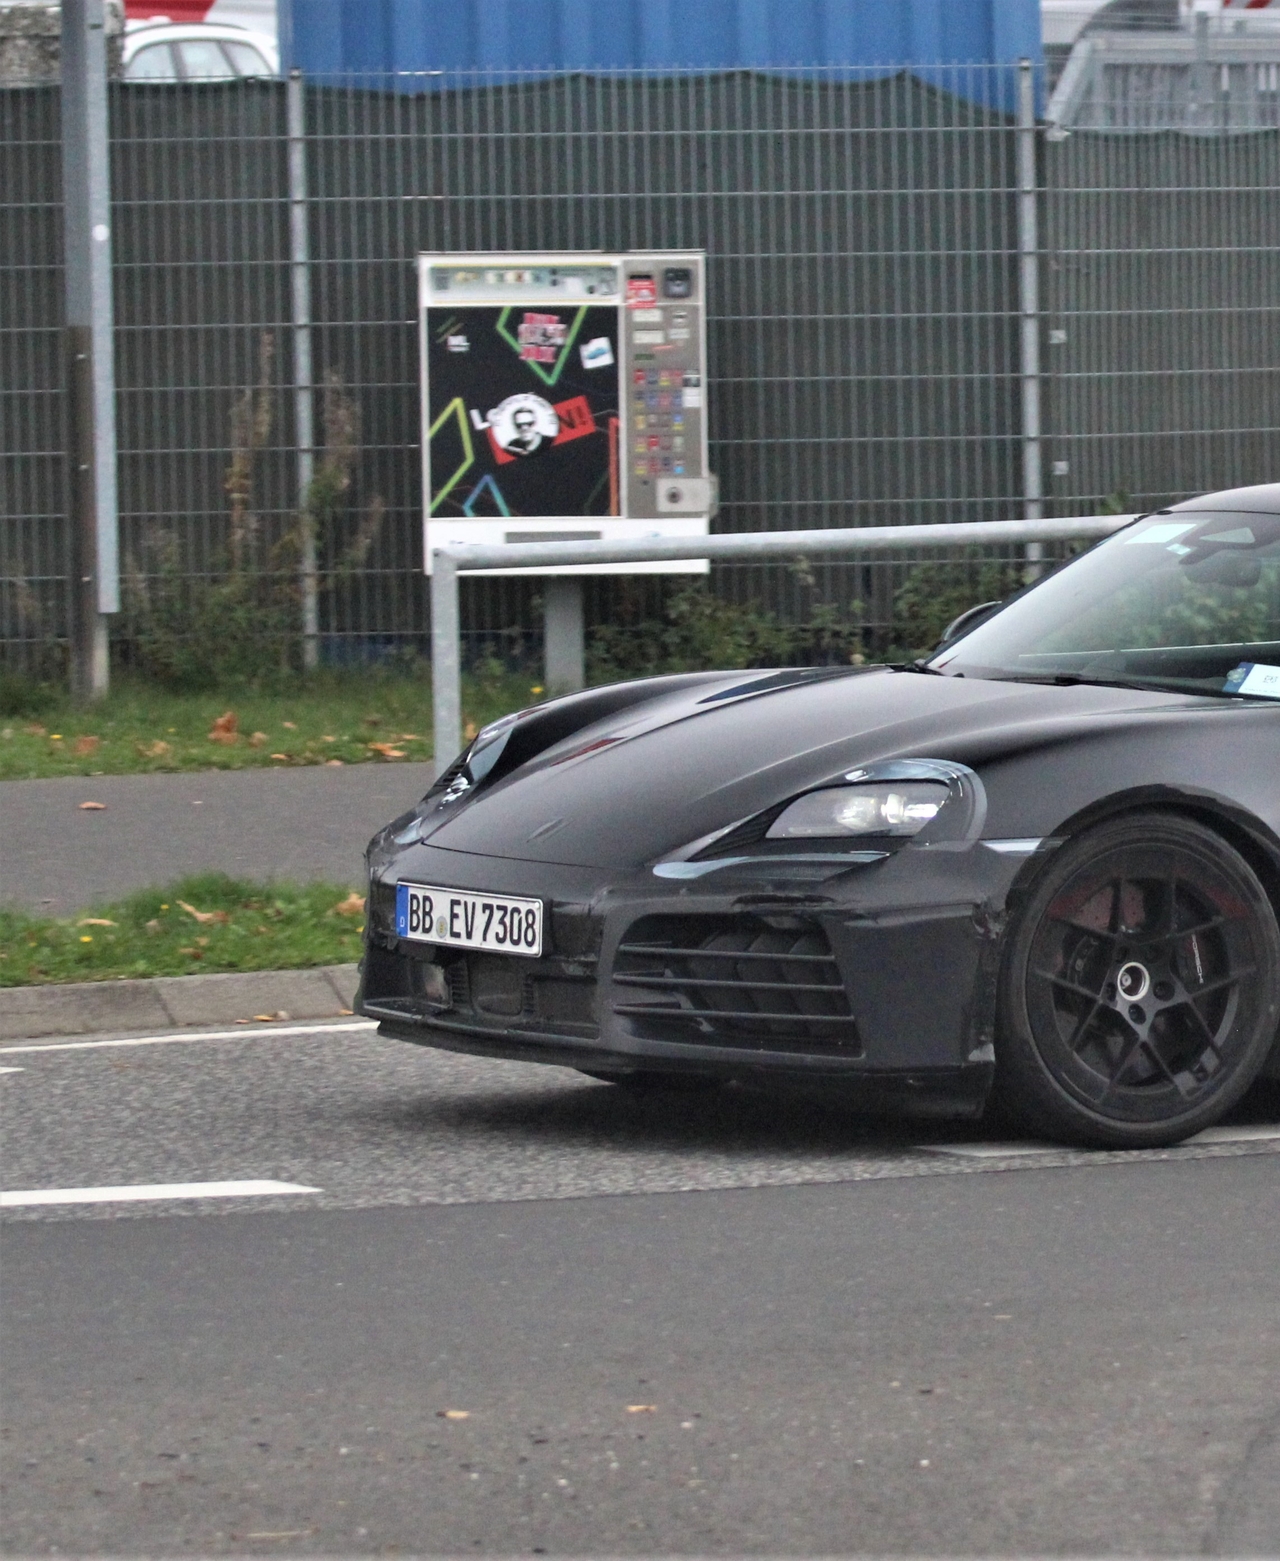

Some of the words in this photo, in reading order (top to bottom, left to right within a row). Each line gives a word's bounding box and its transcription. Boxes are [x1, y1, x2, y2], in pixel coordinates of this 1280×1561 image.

[409, 893, 434, 934] BB
[450, 898, 476, 940] EV
[482, 902, 537, 948] 7308
